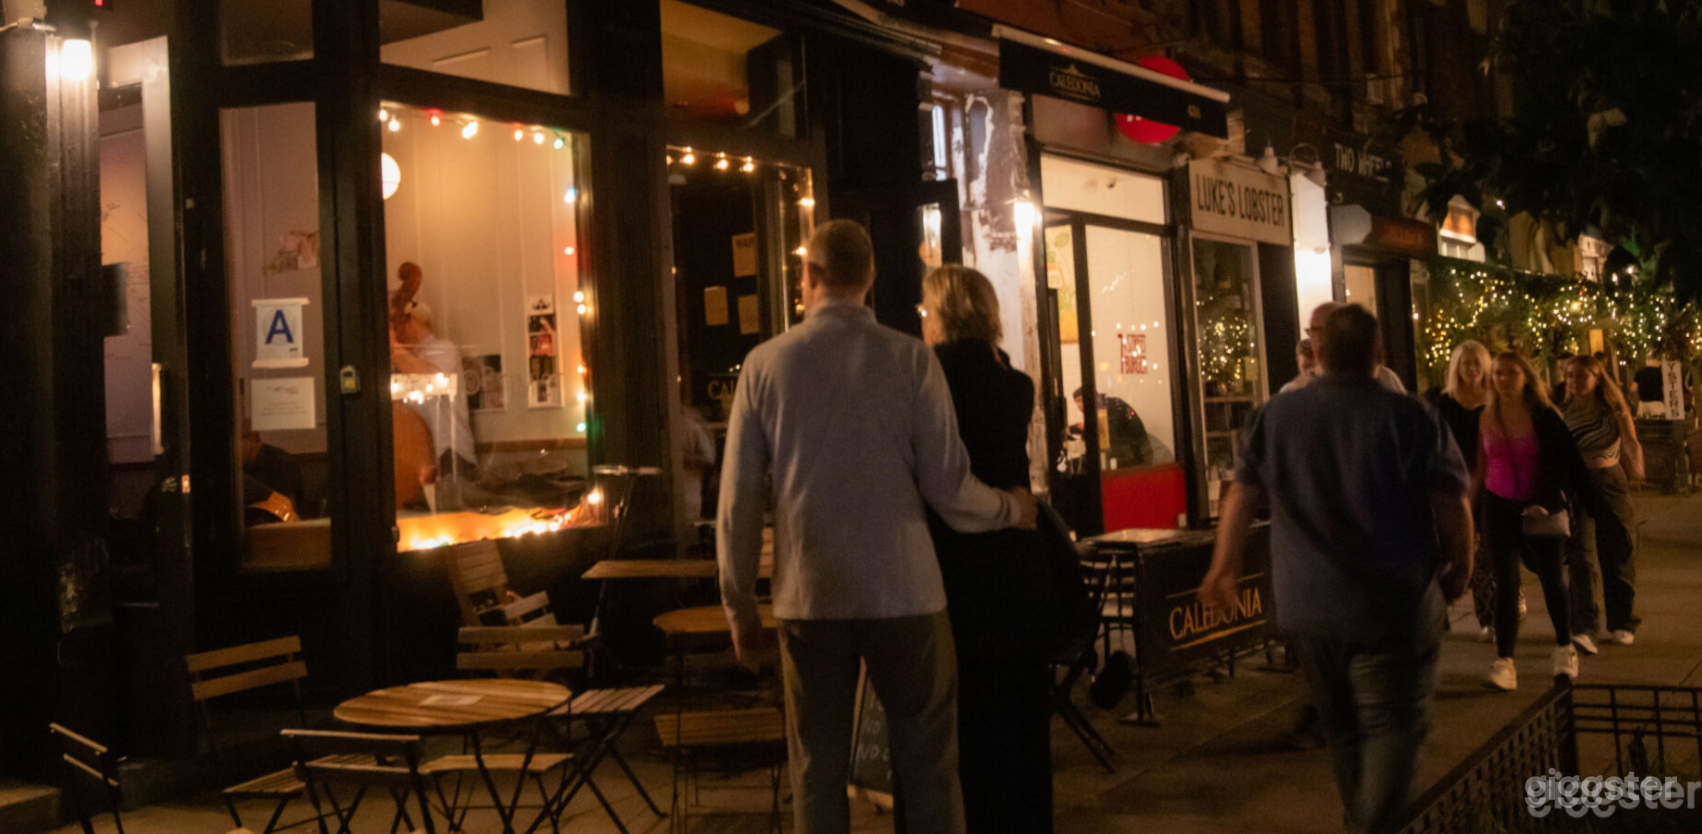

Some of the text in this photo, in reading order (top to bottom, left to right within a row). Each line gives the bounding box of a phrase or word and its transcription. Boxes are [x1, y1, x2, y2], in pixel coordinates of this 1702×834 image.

[1049, 71, 1102, 98] CALEDONIA
[1333, 143, 1355, 173] TWO
[1196, 173, 1285, 227] LUKE'S LOBSTER
[265, 309, 294, 344] A
